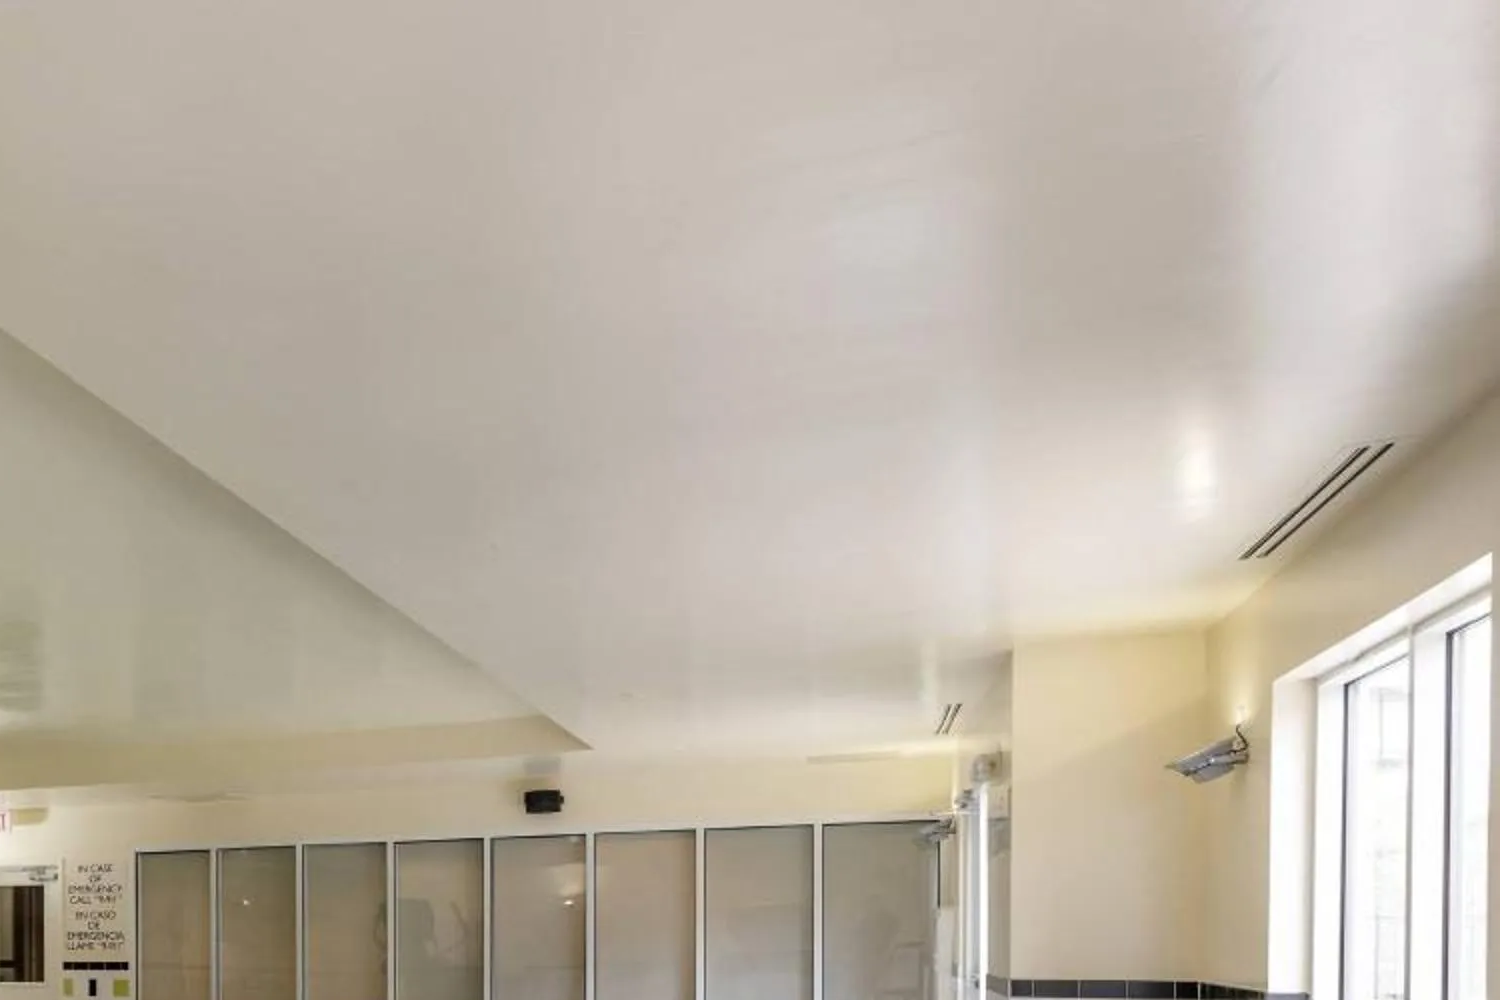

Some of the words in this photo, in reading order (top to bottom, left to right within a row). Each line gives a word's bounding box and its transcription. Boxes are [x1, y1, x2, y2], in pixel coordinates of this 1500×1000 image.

[90, 864, 113, 873] CASE
[67, 885, 122, 894] EMERGENCY
[69, 895, 92, 904] CALL
[90, 911, 117, 920] CASO
[67, 932, 125, 940] EMERGENCIA
[67, 941, 95, 950] LLAME
